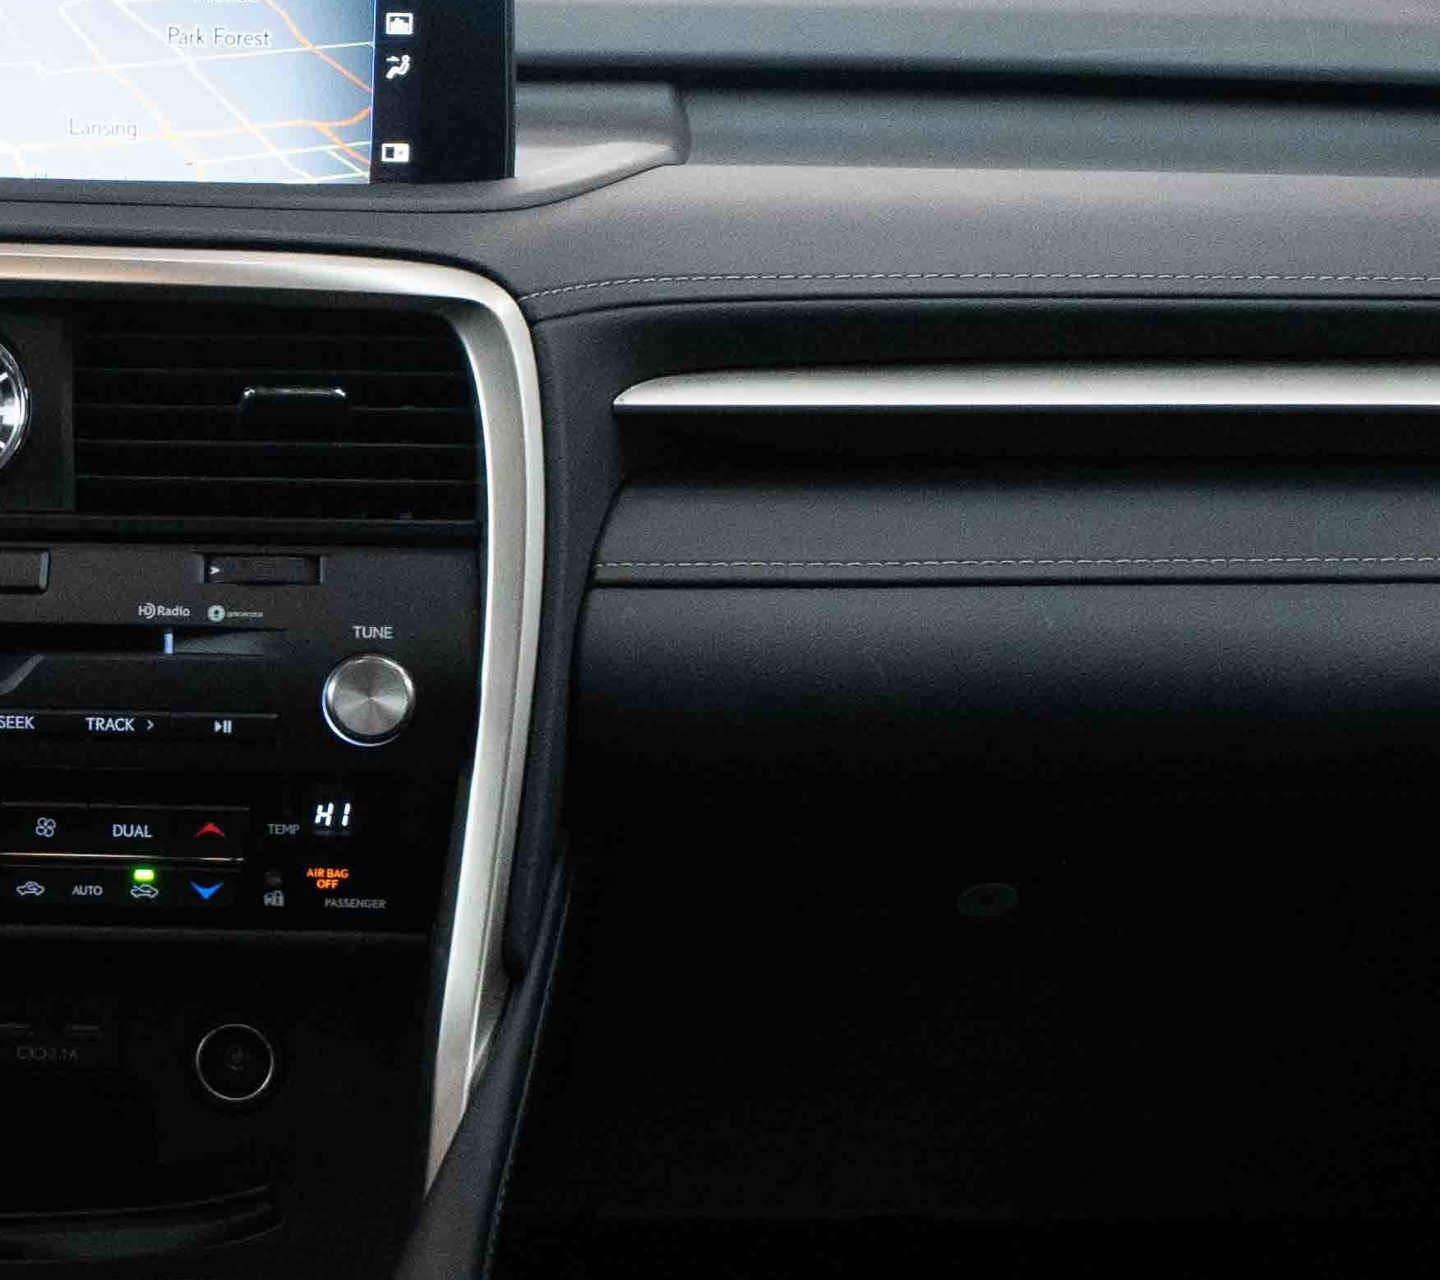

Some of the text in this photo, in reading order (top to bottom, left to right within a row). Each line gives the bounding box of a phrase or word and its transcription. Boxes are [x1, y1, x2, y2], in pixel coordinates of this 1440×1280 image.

[166, 27, 271, 47] Park Forest
[67, 119, 138, 140] Lansing
[157, 604, 191, 618] Radio
[352, 625, 394, 640] TUNE
[86, 717, 135, 732] TRACK
[315, 802, 351, 827] HI
[112, 824, 152, 839] DUAL
[267, 823, 300, 836] TEMP
[306, 868, 349, 879] AIR BAG
[72, 884, 103, 897] AUTO
[316, 878, 339, 890] OFF
[324, 898, 386, 910] PASSENGER
